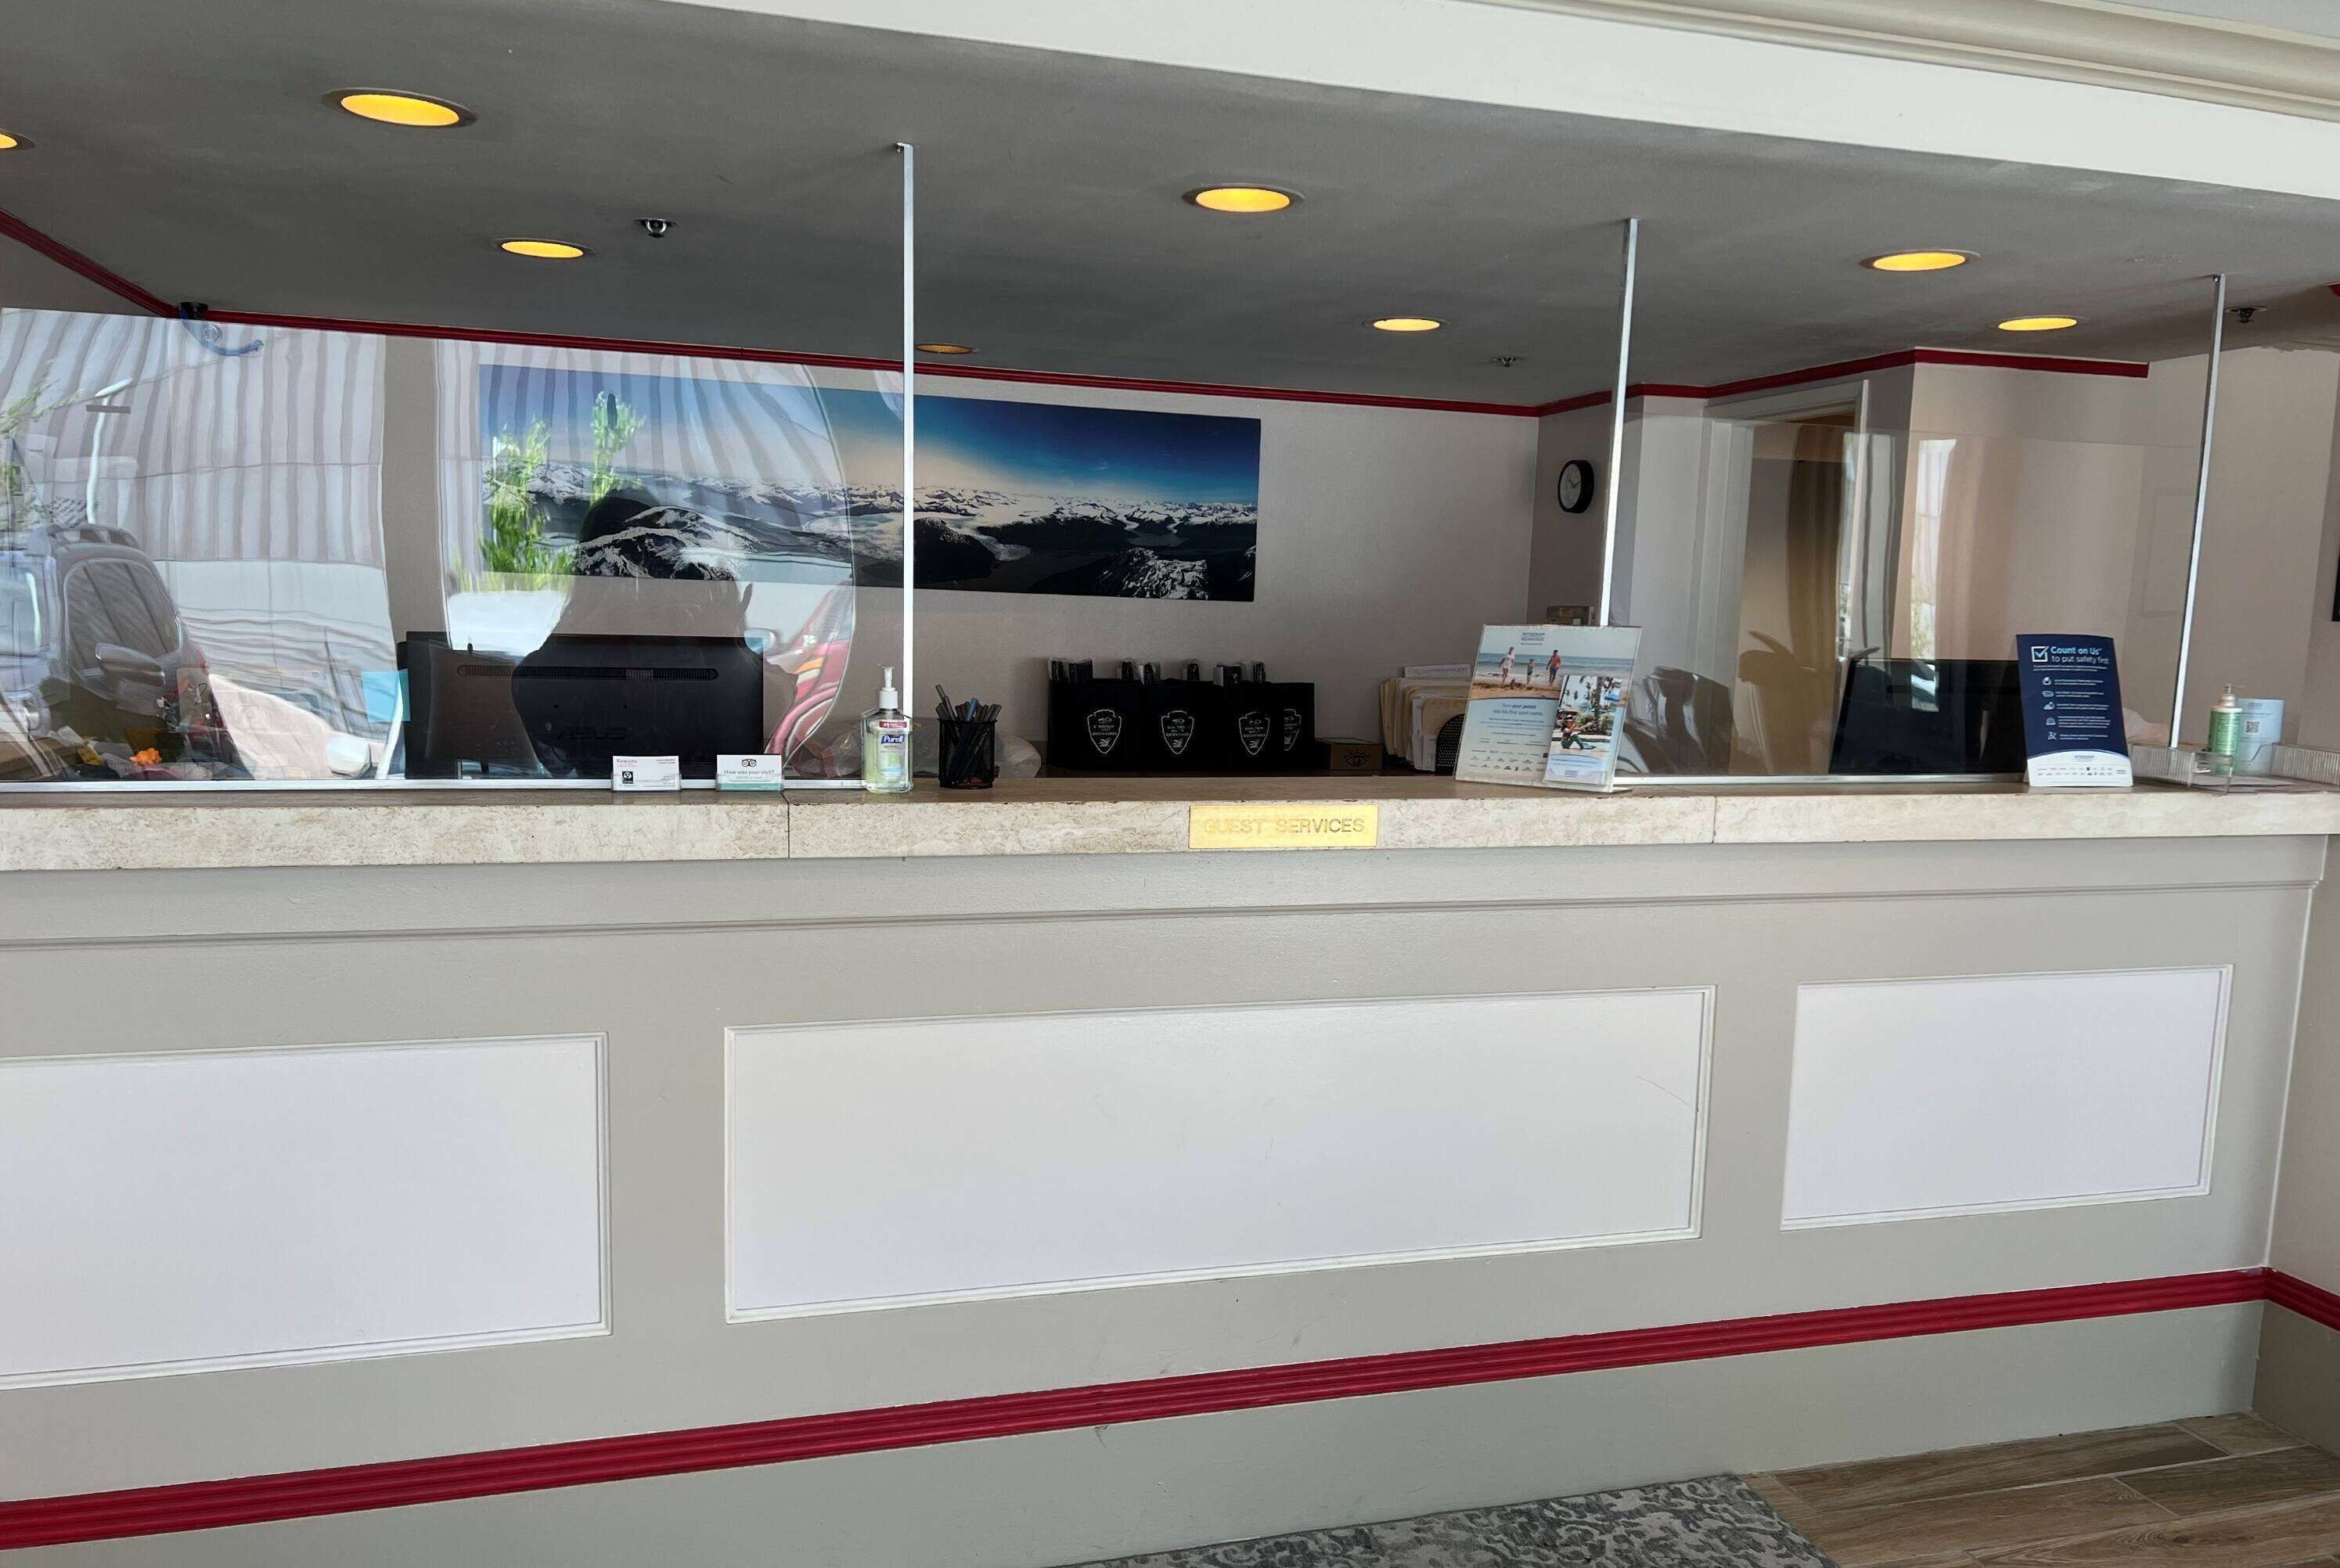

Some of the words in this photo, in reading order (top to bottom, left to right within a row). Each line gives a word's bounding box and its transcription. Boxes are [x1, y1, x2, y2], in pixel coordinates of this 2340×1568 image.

[2050, 646, 2076, 654] Count
[883, 734, 904, 743] Purell
[1203, 818, 1265, 834] GUEST
[1275, 818, 1366, 833] SERVICES
